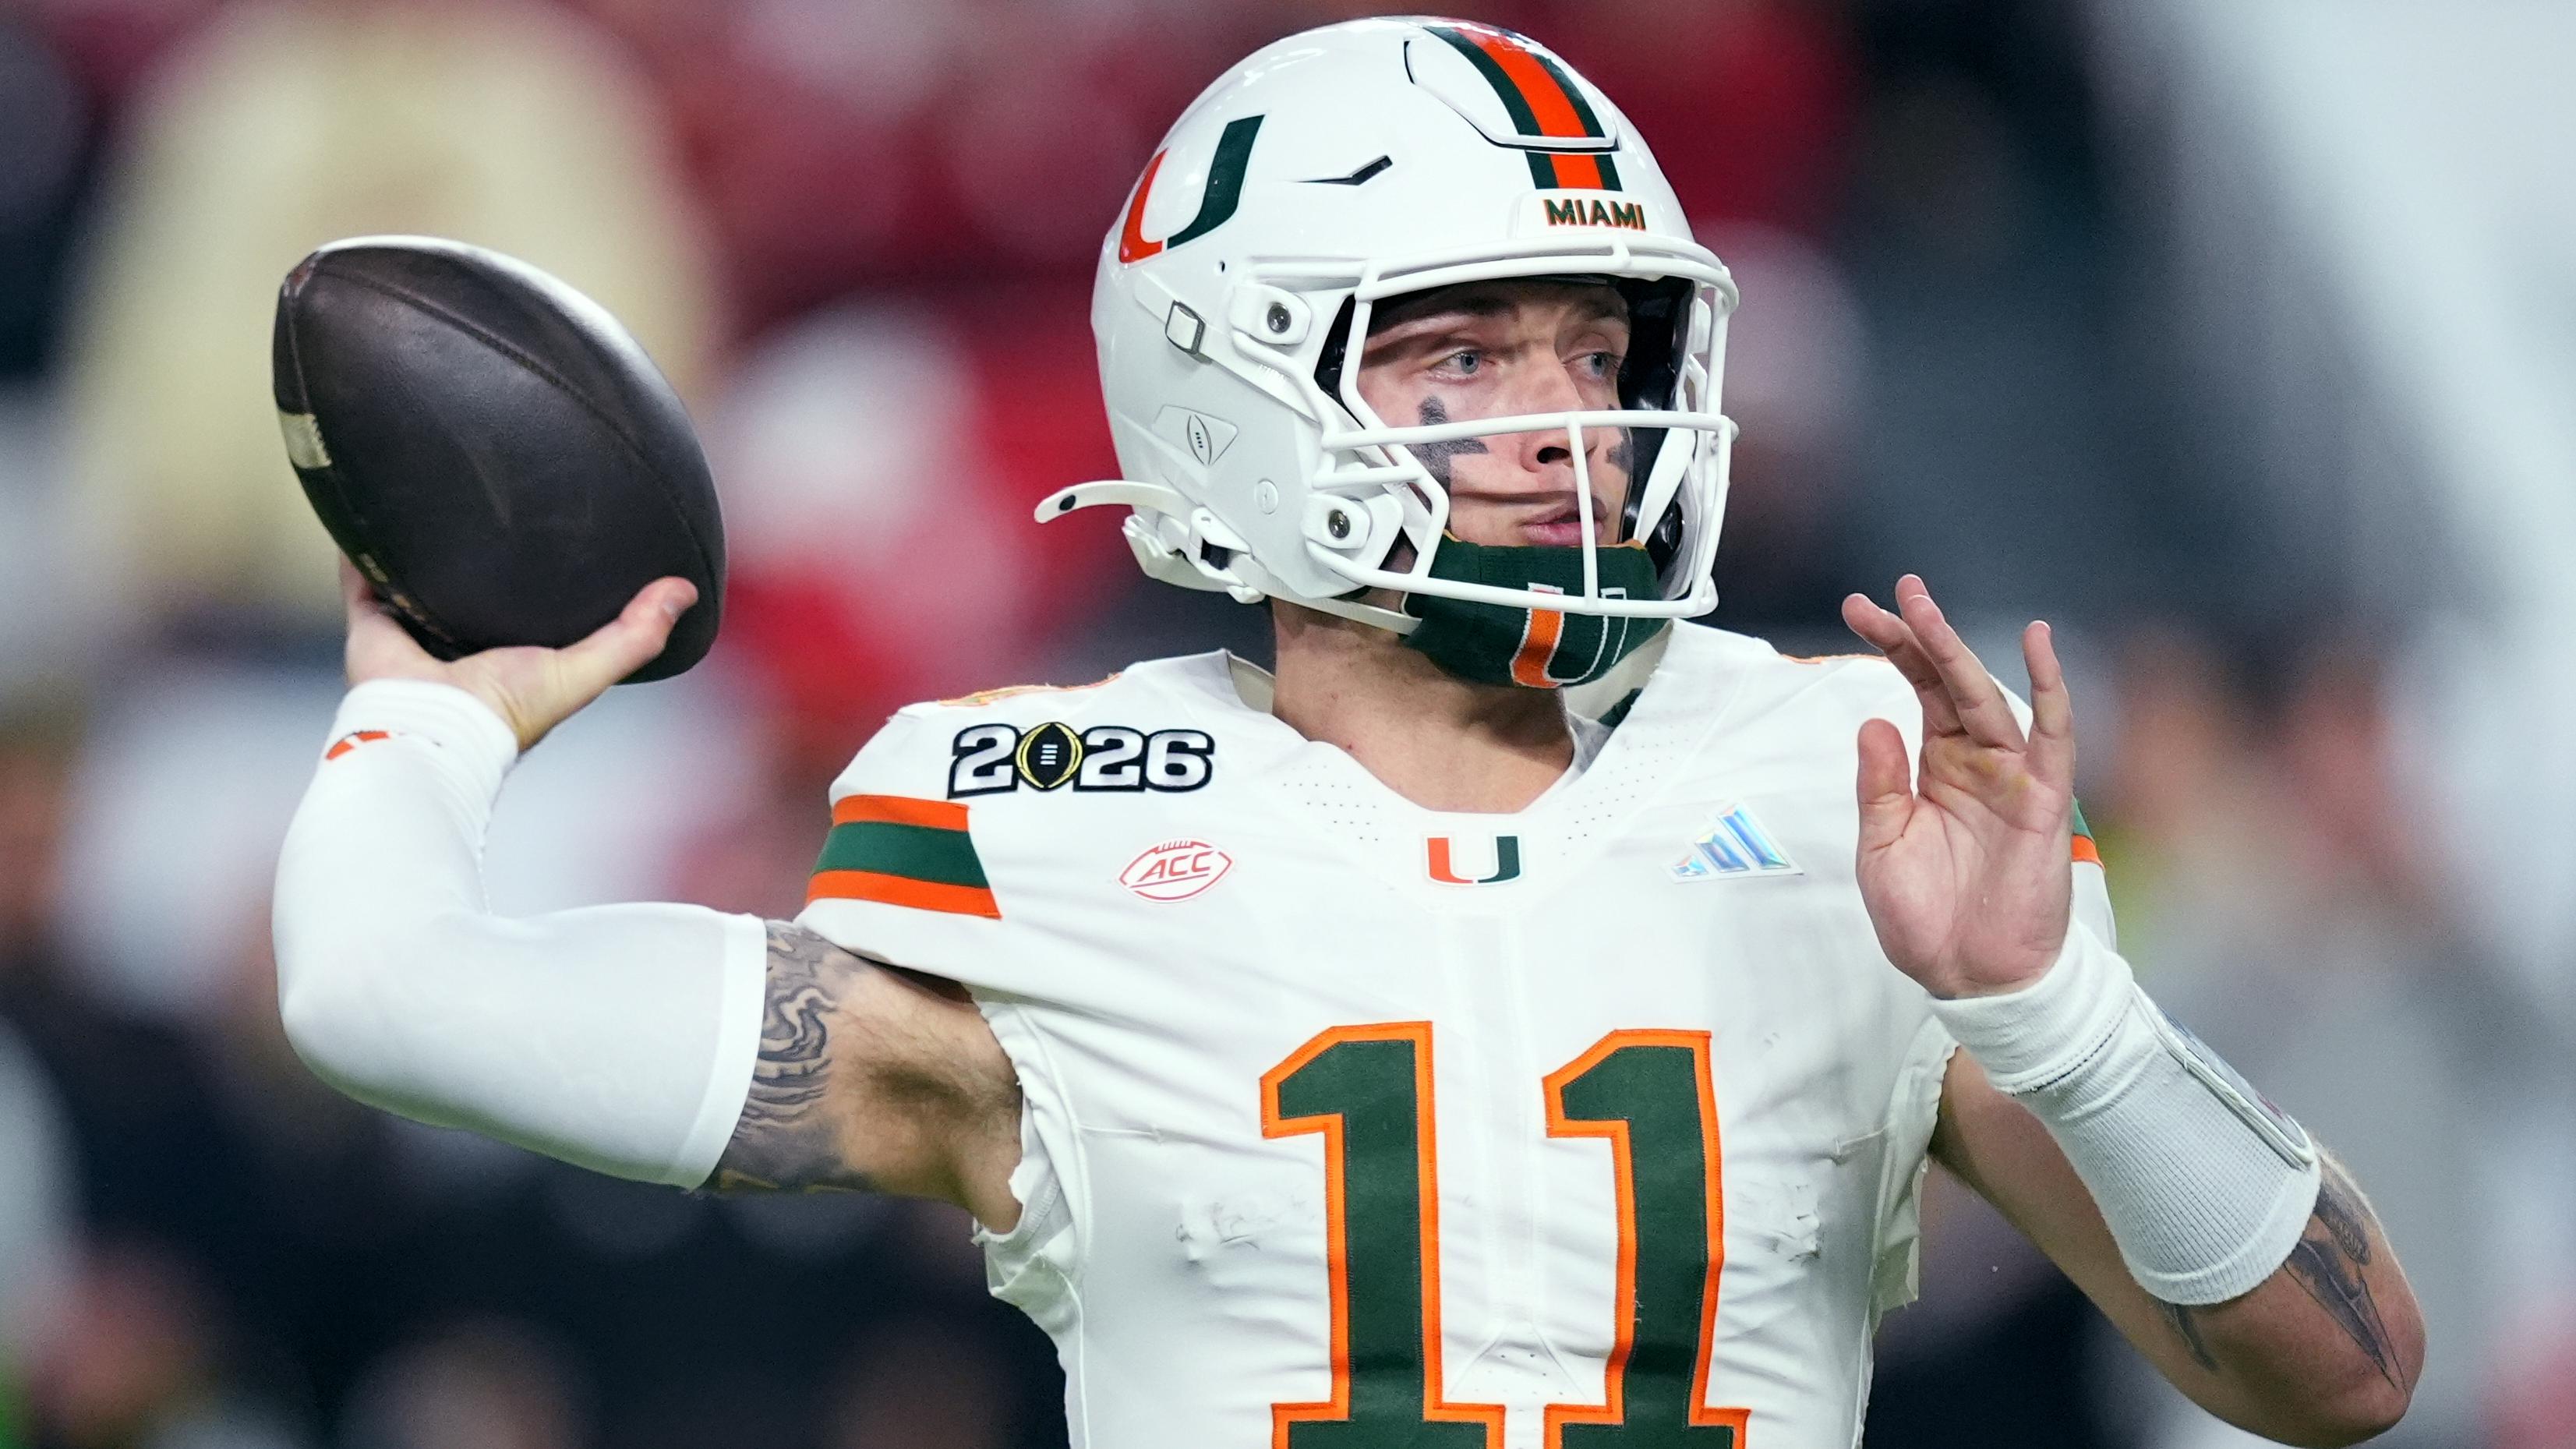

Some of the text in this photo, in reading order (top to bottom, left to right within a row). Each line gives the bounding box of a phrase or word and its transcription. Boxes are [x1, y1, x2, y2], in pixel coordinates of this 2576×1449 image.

[1542, 198, 1647, 231] MIAMI
[947, 722, 1214, 799] 2026
[1139, 853, 1212, 882] ACC
[1426, 836, 1520, 885] U
[1260, 1020, 1751, 1449] 11
